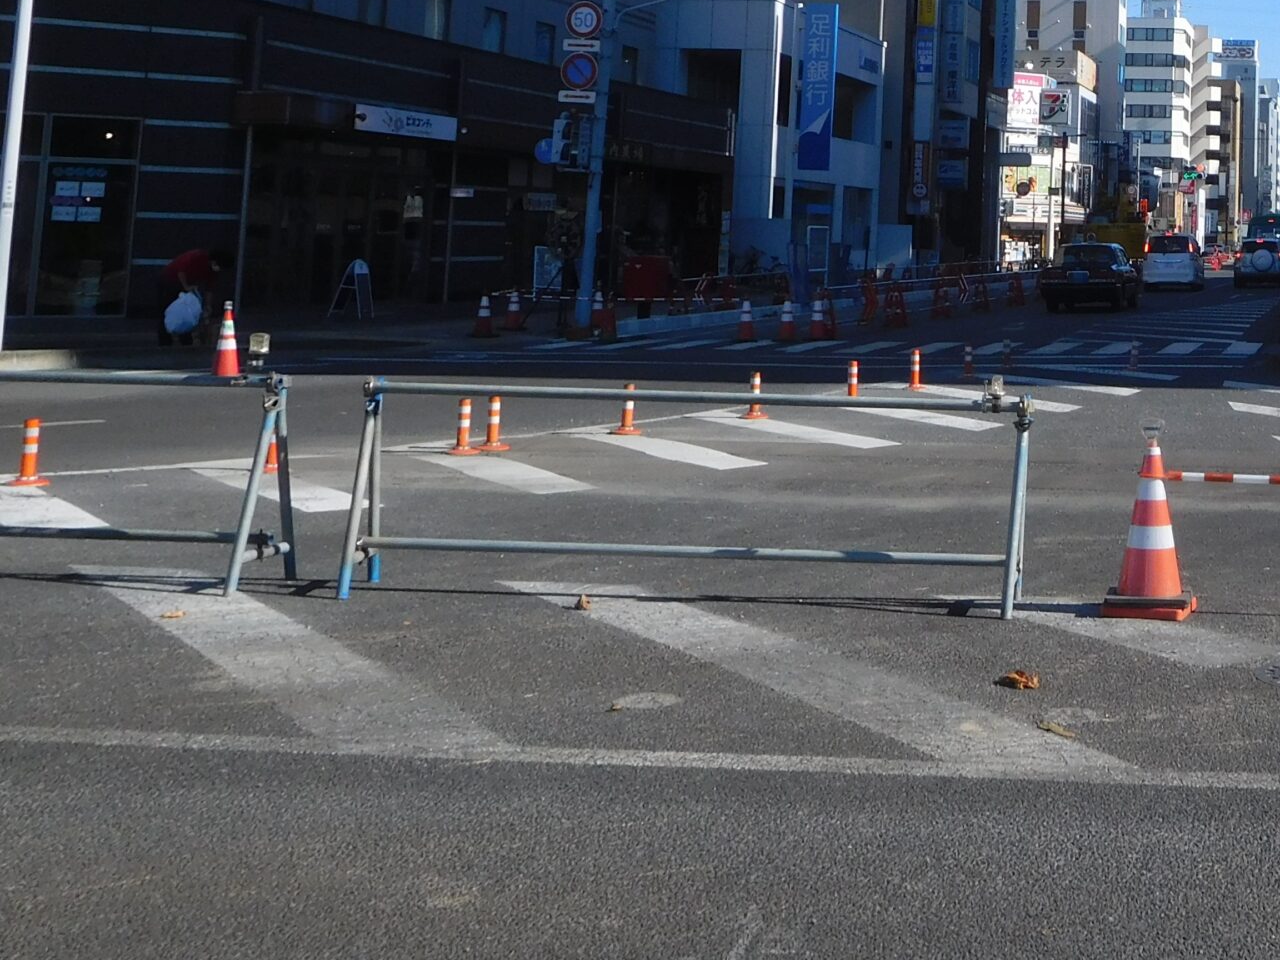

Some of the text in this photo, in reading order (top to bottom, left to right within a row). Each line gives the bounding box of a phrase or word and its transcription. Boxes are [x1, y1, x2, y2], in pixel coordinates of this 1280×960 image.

[574, 12, 594, 28] 50
[806, 14, 832, 106] 足利銀行
[1012, 88, 1037, 105] 体入
